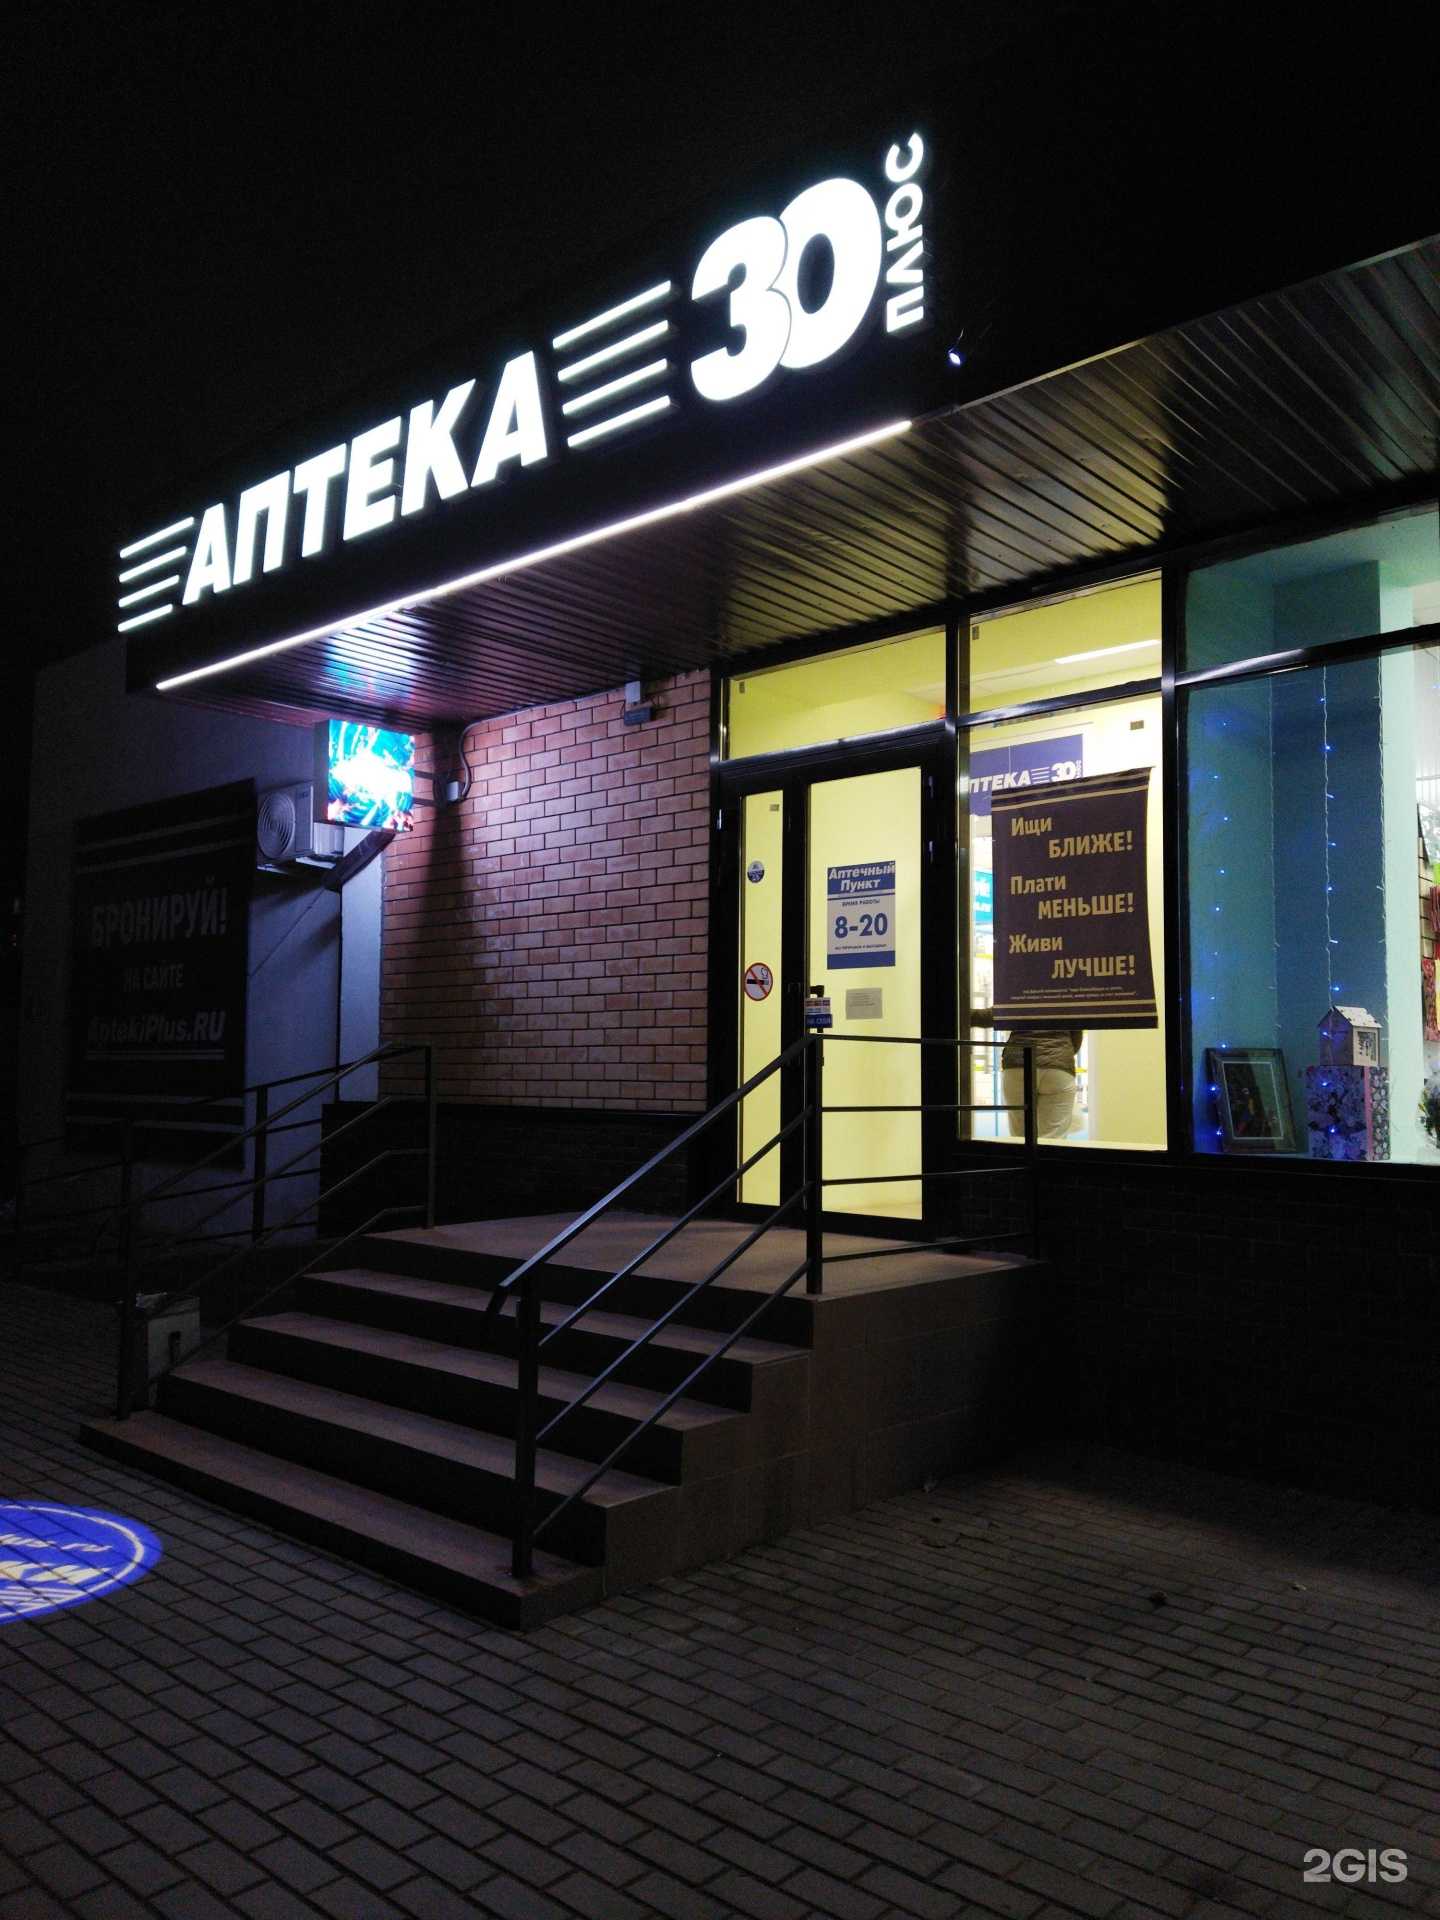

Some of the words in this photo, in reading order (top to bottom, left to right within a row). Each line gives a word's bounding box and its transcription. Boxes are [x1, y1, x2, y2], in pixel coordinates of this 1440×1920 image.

[885, 131, 924, 334] ПЛЮС
[181, 350, 549, 606] АПТЕКА
[690, 176, 883, 402] 30
[967, 770, 1032, 793] ПТЕКА
[1010, 816, 1053, 837] Ищи
[1048, 830, 1134, 859] БЛИЖЕ!
[828, 861, 895, 880] Аптечный
[840, 879, 881, 893] Пункт
[1010, 875, 1067, 896] Плати
[90, 874, 228, 949] БРОНИРУЙ!
[1037, 892, 1135, 920] МЕНЬШЕ!
[834, 912, 888, 939] 8-20
[1008, 933, 1063, 954] Живи
[1051, 954, 1136, 980] ЛУЧШЕ!
